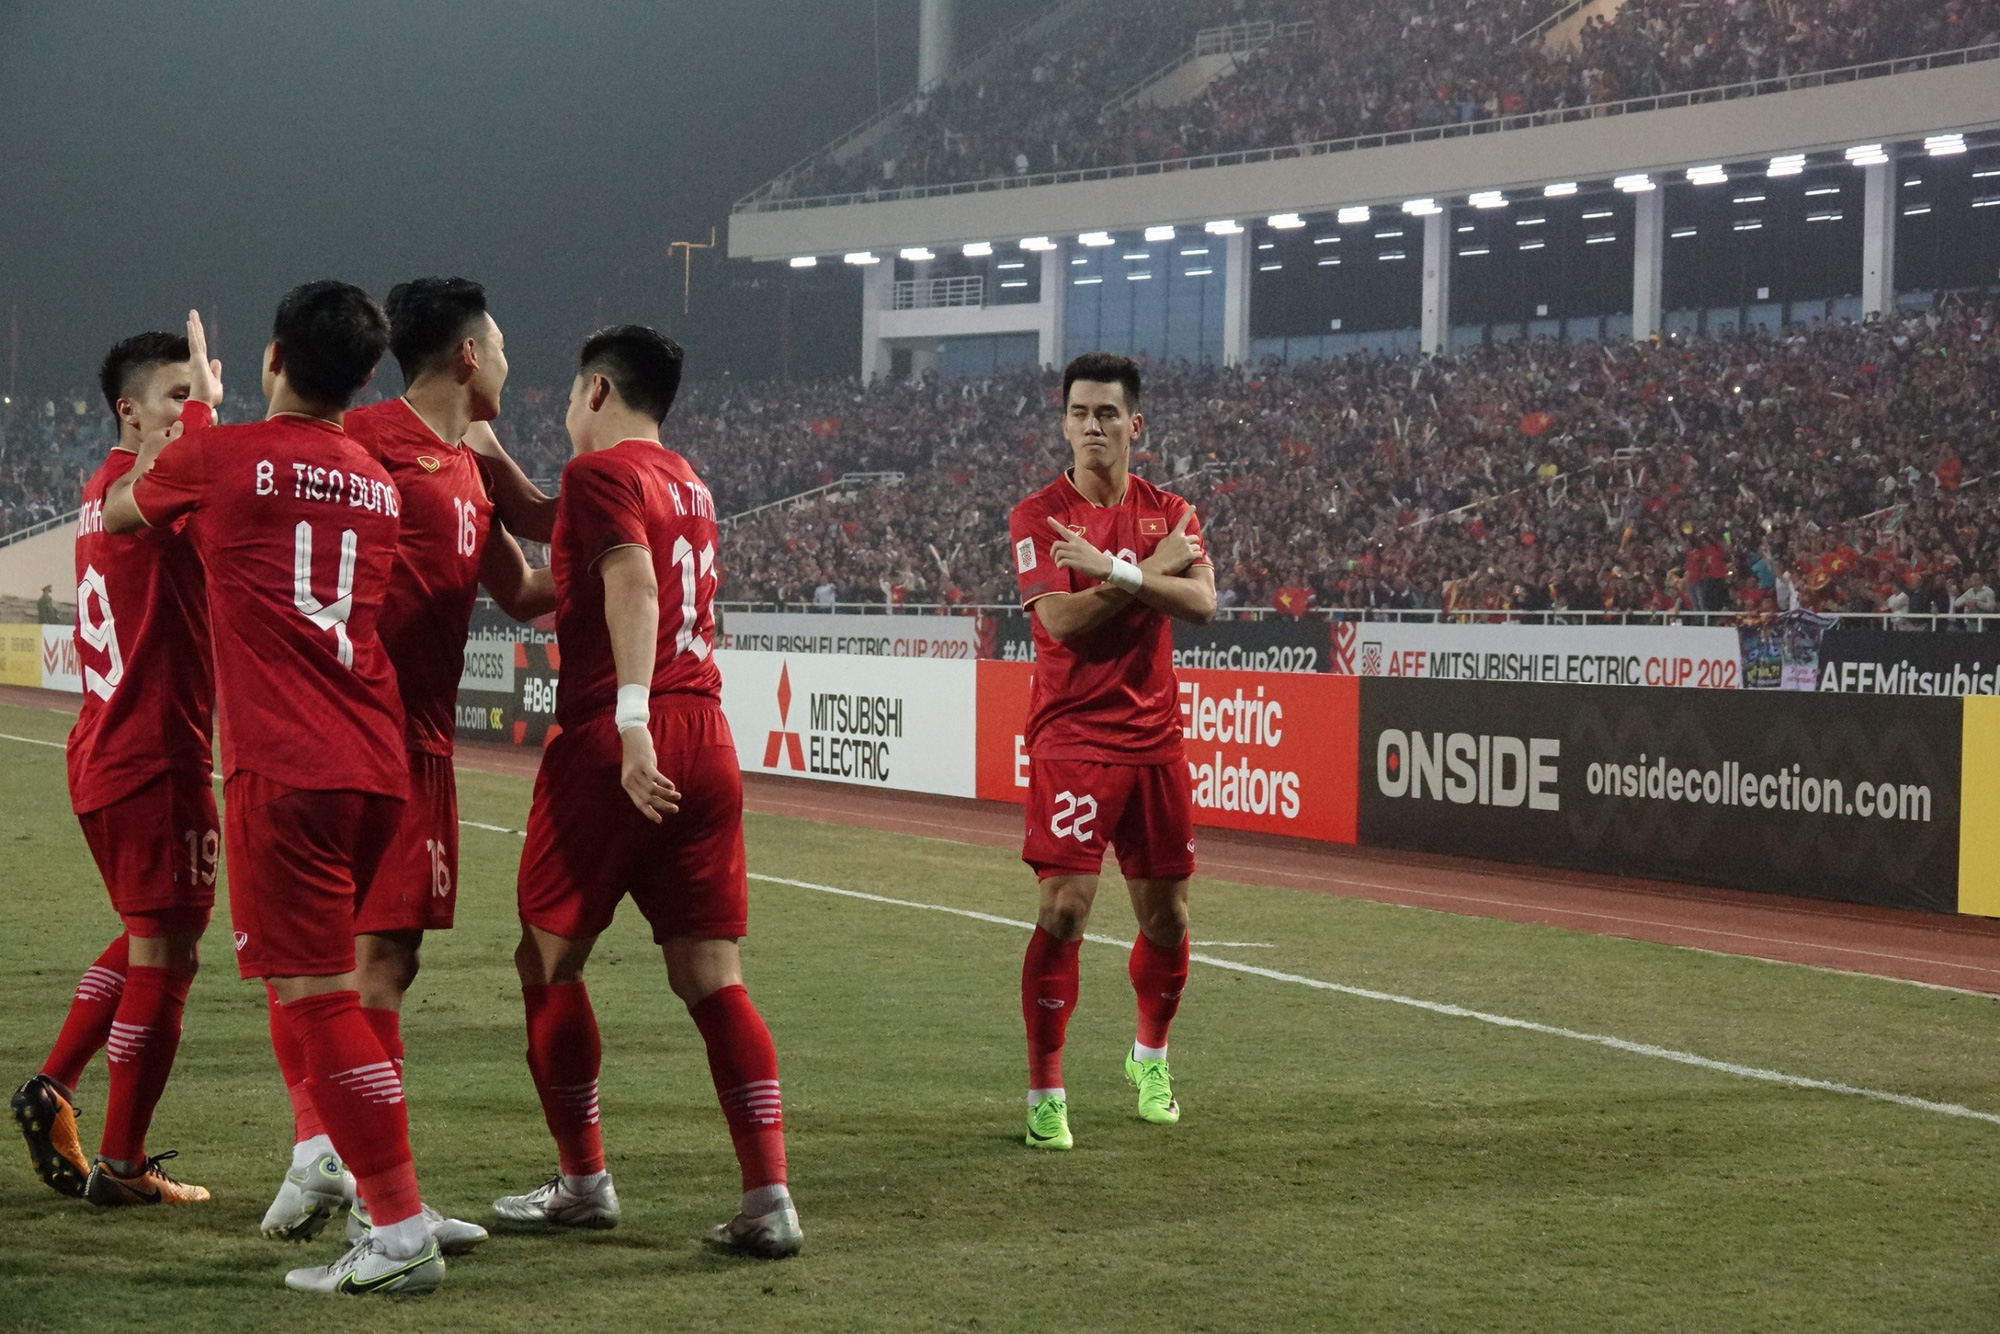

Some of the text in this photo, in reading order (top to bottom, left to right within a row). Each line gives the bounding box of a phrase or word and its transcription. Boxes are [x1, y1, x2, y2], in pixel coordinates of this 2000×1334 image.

[256, 460, 279, 495] B.
[453, 496, 477, 557] 16
[294, 520, 357, 671] 4
[464, 652, 504, 680] ACCESS
[735, 633, 816, 654] MITSUBISHI
[819, 636, 891, 656] ELECTRIC
[894, 638, 929, 658] CUP
[931, 639, 969, 660] 2022
[1388, 650, 1427, 677] AFF
[1430, 652, 1538, 681] MITSUBISHI
[1542, 654, 1641, 685] ELECTRIC
[1645, 656, 1693, 687] CUP
[1697, 658, 1741, 689] 202
[810, 692, 903, 738] MITSUBISHI
[809, 736, 889, 782] ELECTRIC
[1377, 728, 1560, 812] ONSIDE
[1586, 753, 1932, 822] onsidecollection.com
[1050, 790, 1098, 842] 22
[184, 828, 219, 887] 19
[426, 838, 452, 898] 16
